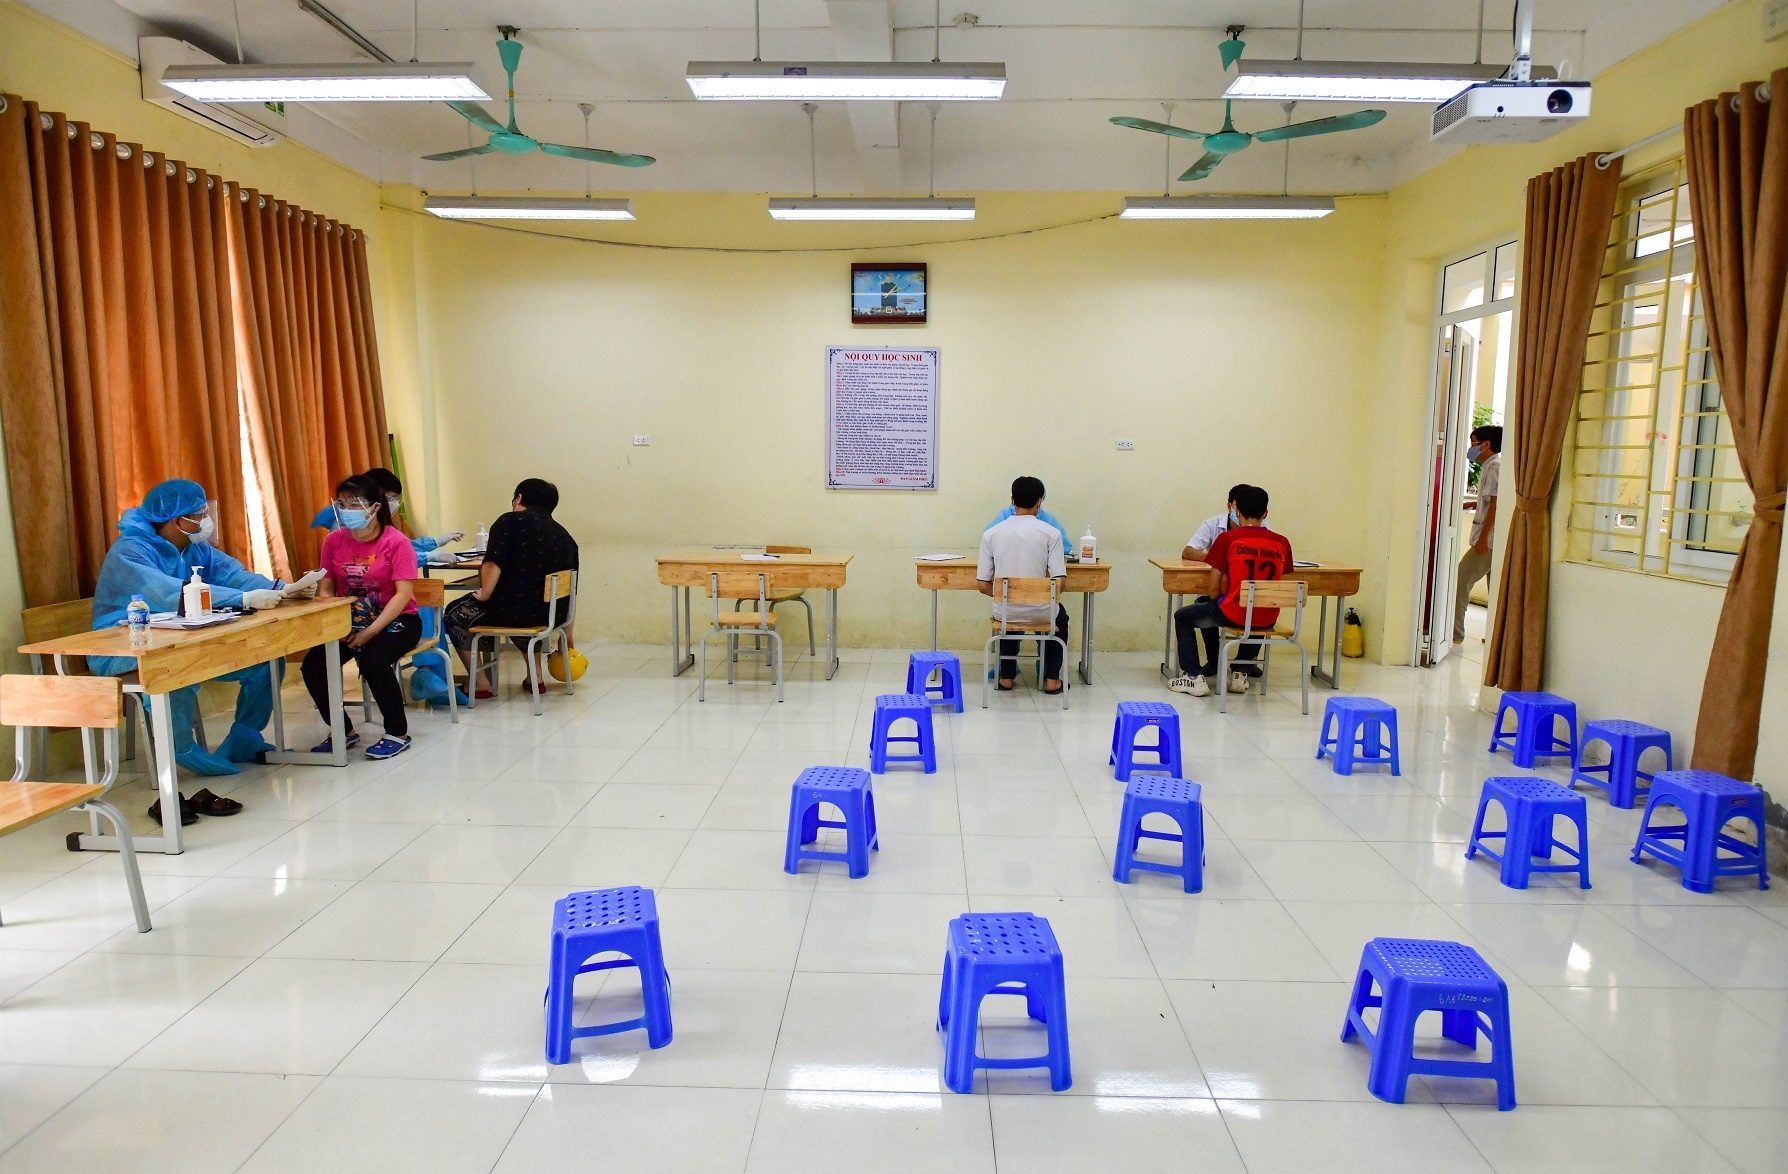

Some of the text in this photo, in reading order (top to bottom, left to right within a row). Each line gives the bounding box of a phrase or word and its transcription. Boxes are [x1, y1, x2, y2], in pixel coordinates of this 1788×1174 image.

[844, 352, 922, 362] NỘI QUY HỌC SINH
[1244, 559, 1276, 580] 12
